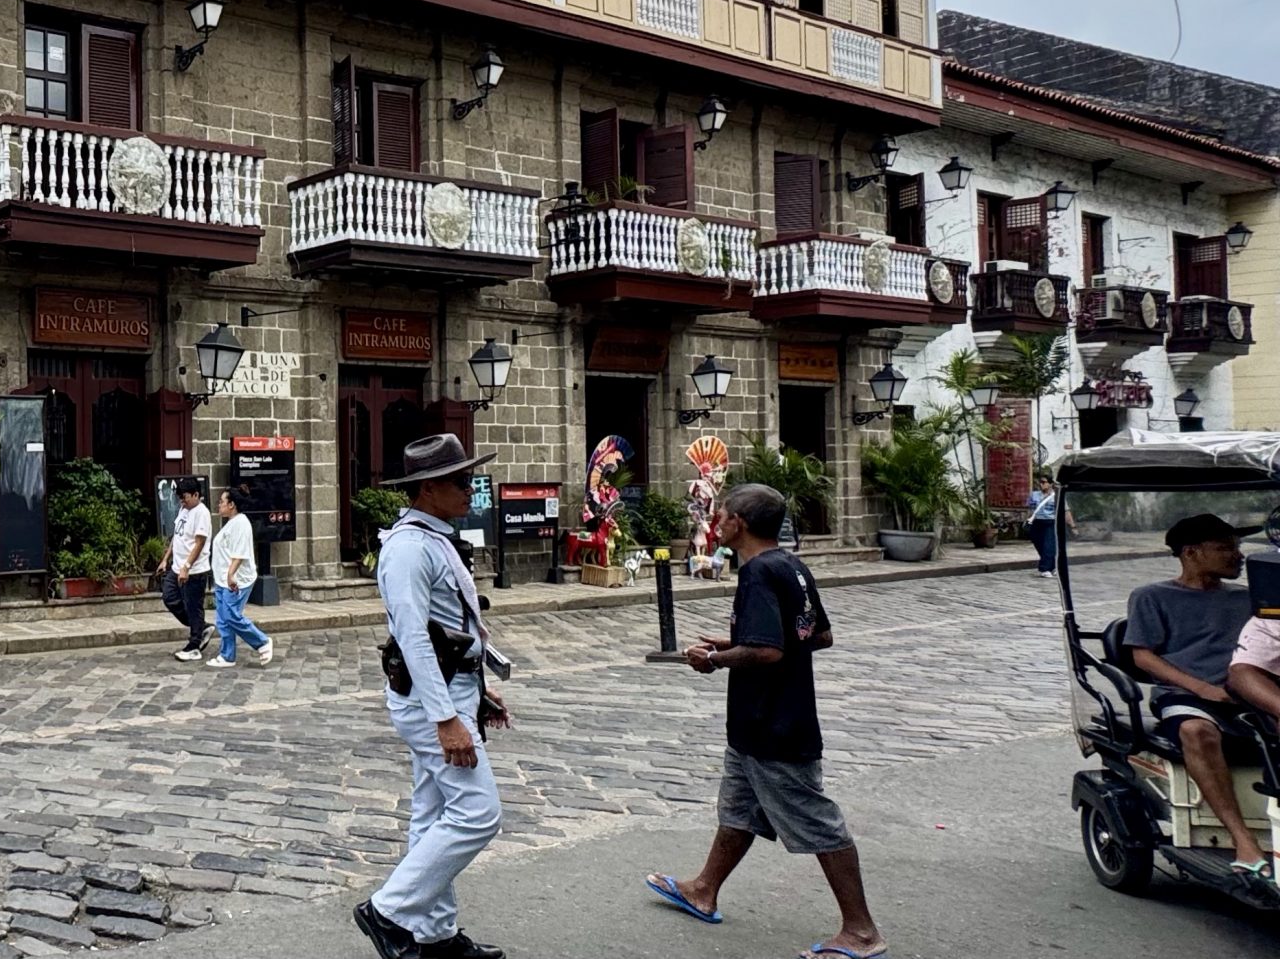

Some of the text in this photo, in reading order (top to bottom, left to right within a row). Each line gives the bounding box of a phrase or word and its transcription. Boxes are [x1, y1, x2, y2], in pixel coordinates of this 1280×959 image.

[73, 297, 118, 315] CAFE
[39, 313, 150, 336] INTRAMUROS
[373, 317, 407, 332] CAFE
[348, 332, 431, 350] INTRAMUROS
[260, 354, 298, 366] LUNA
[271, 370, 288, 382] DE
[505, 512, 545, 523] Casa Manila
